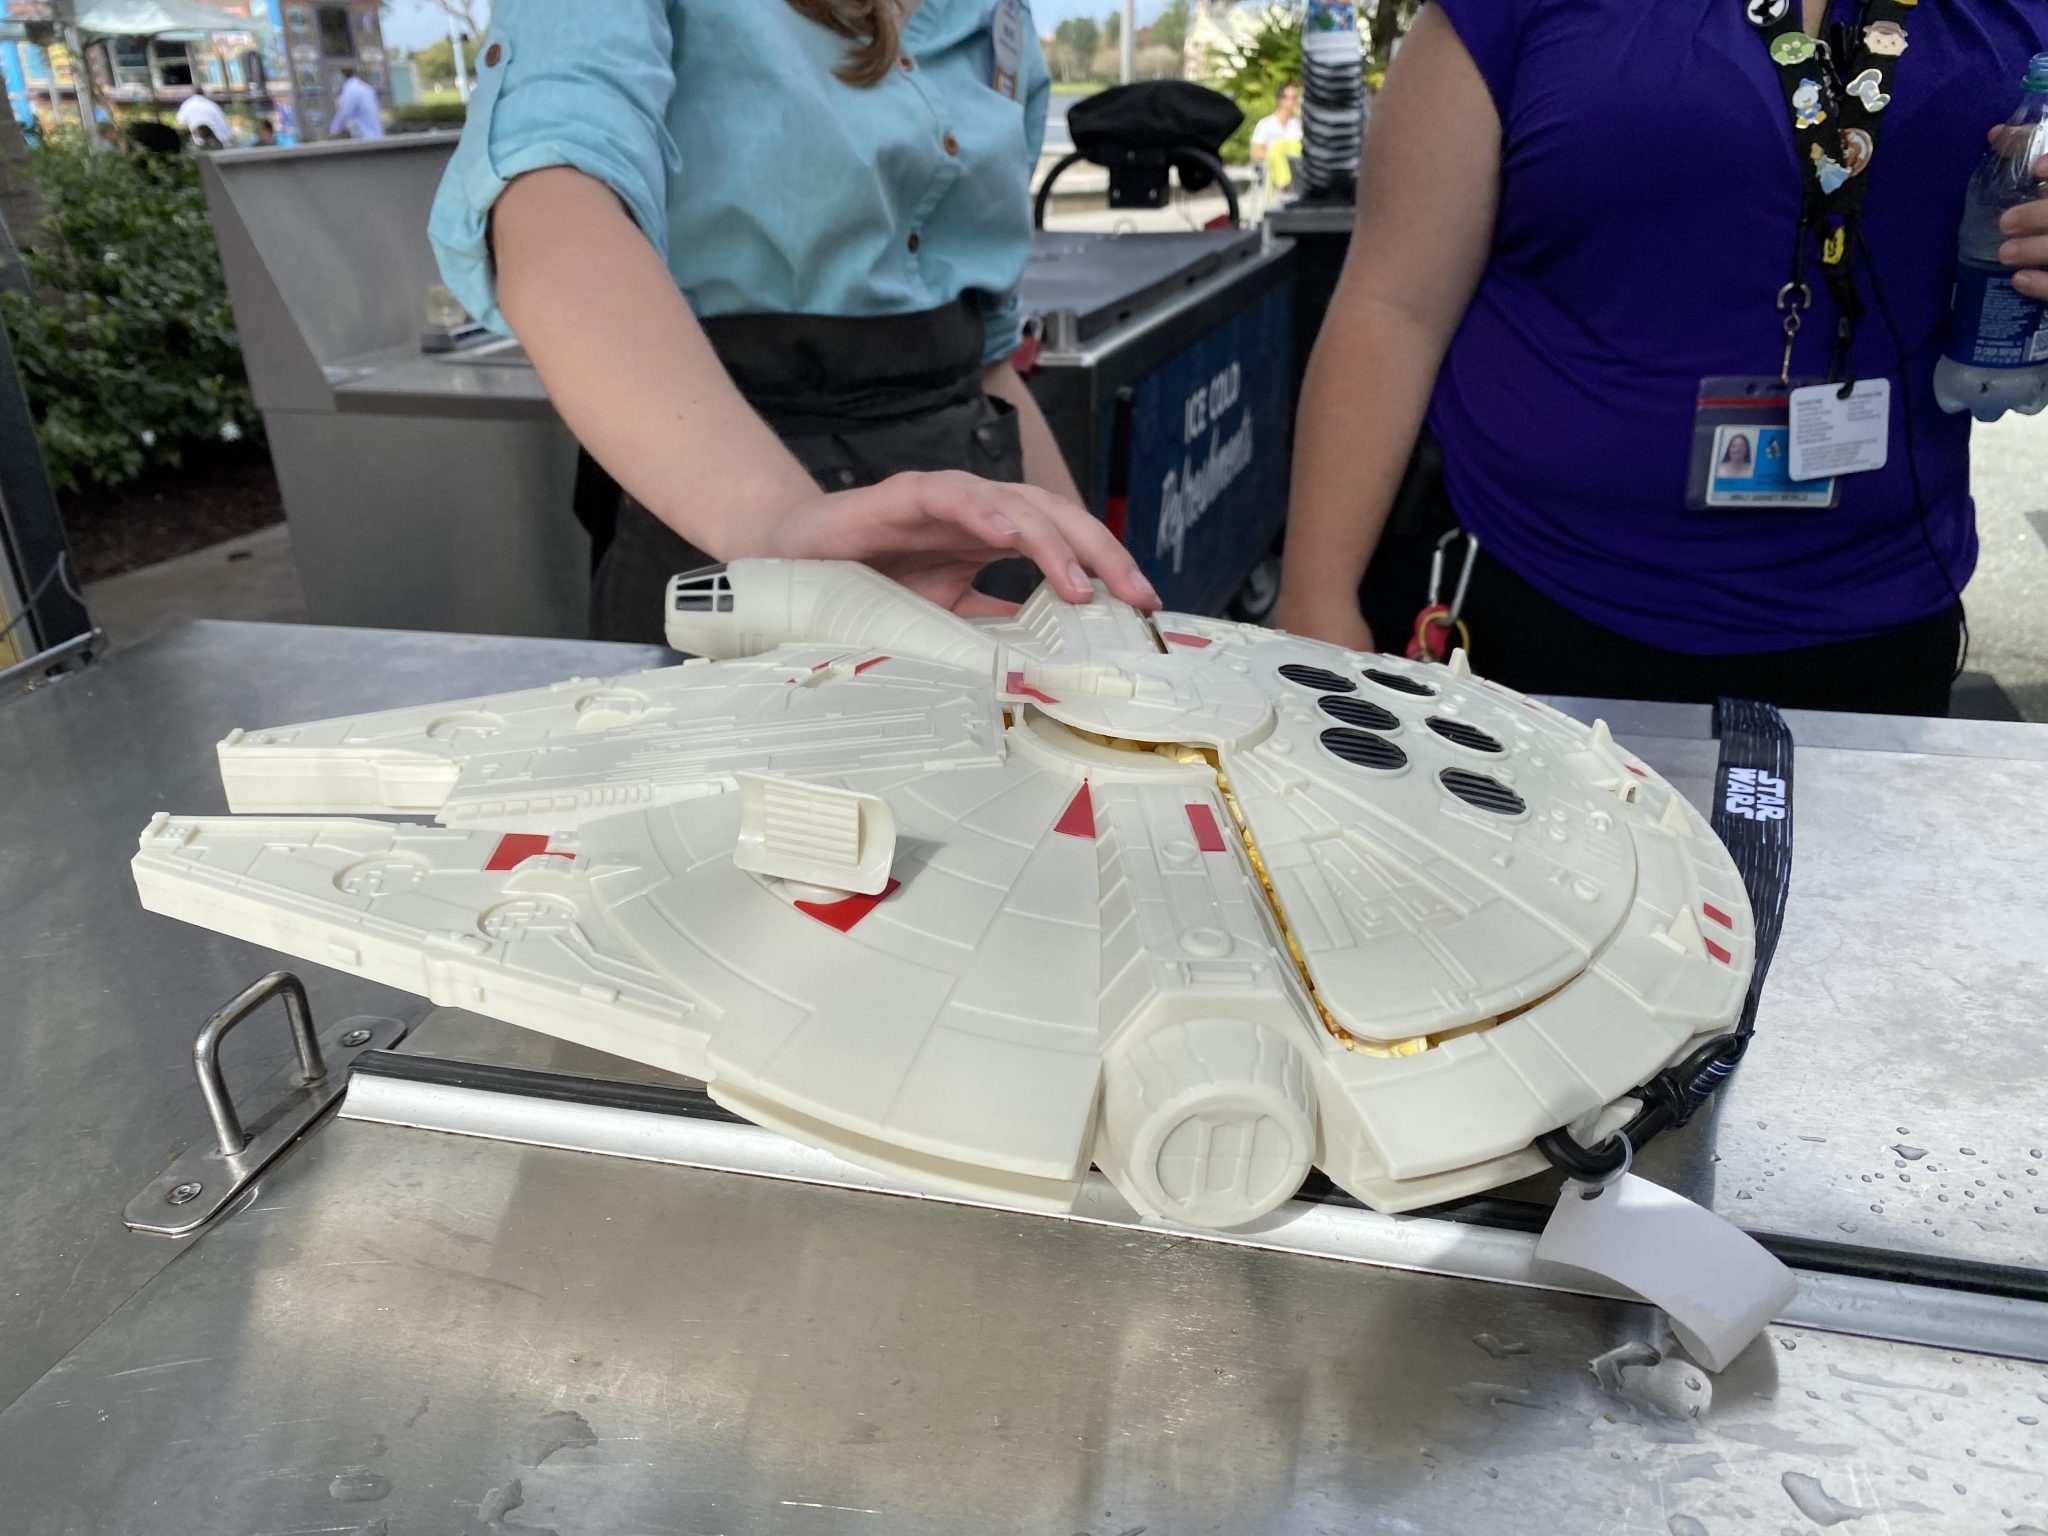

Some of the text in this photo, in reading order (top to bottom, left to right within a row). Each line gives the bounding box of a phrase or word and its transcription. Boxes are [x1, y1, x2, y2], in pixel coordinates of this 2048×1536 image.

[1184, 360, 1241, 445] ICE COLD
[1726, 767, 1757, 820] WARS
[1756, 770, 1786, 821] STAR
